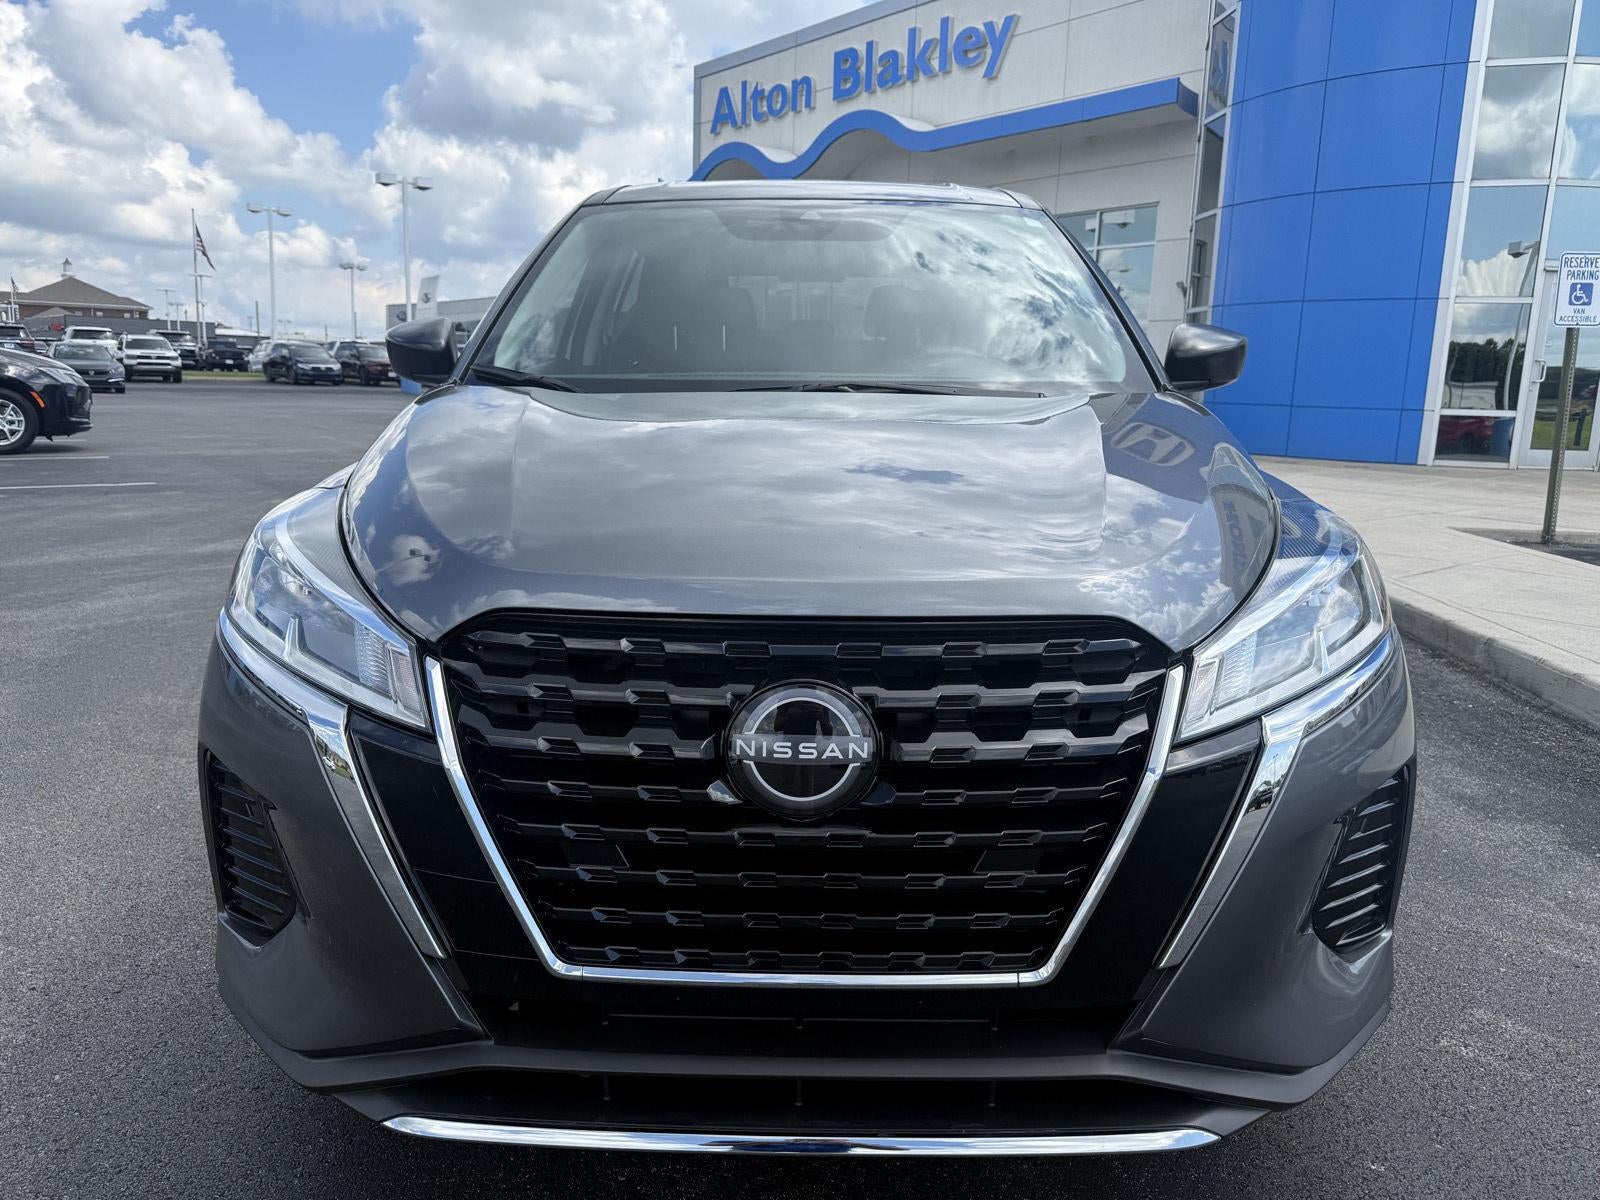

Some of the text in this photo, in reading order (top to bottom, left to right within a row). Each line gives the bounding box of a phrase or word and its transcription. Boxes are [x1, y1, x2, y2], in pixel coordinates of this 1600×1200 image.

[710, 14, 1020, 135] Alton Blakley
[1563, 256, 1600, 268] RESERVE
[1566, 269, 1600, 281] PARKING
[1558, 315, 1598, 323] ACCESSIBLE
[735, 738, 868, 760] NISSAN
